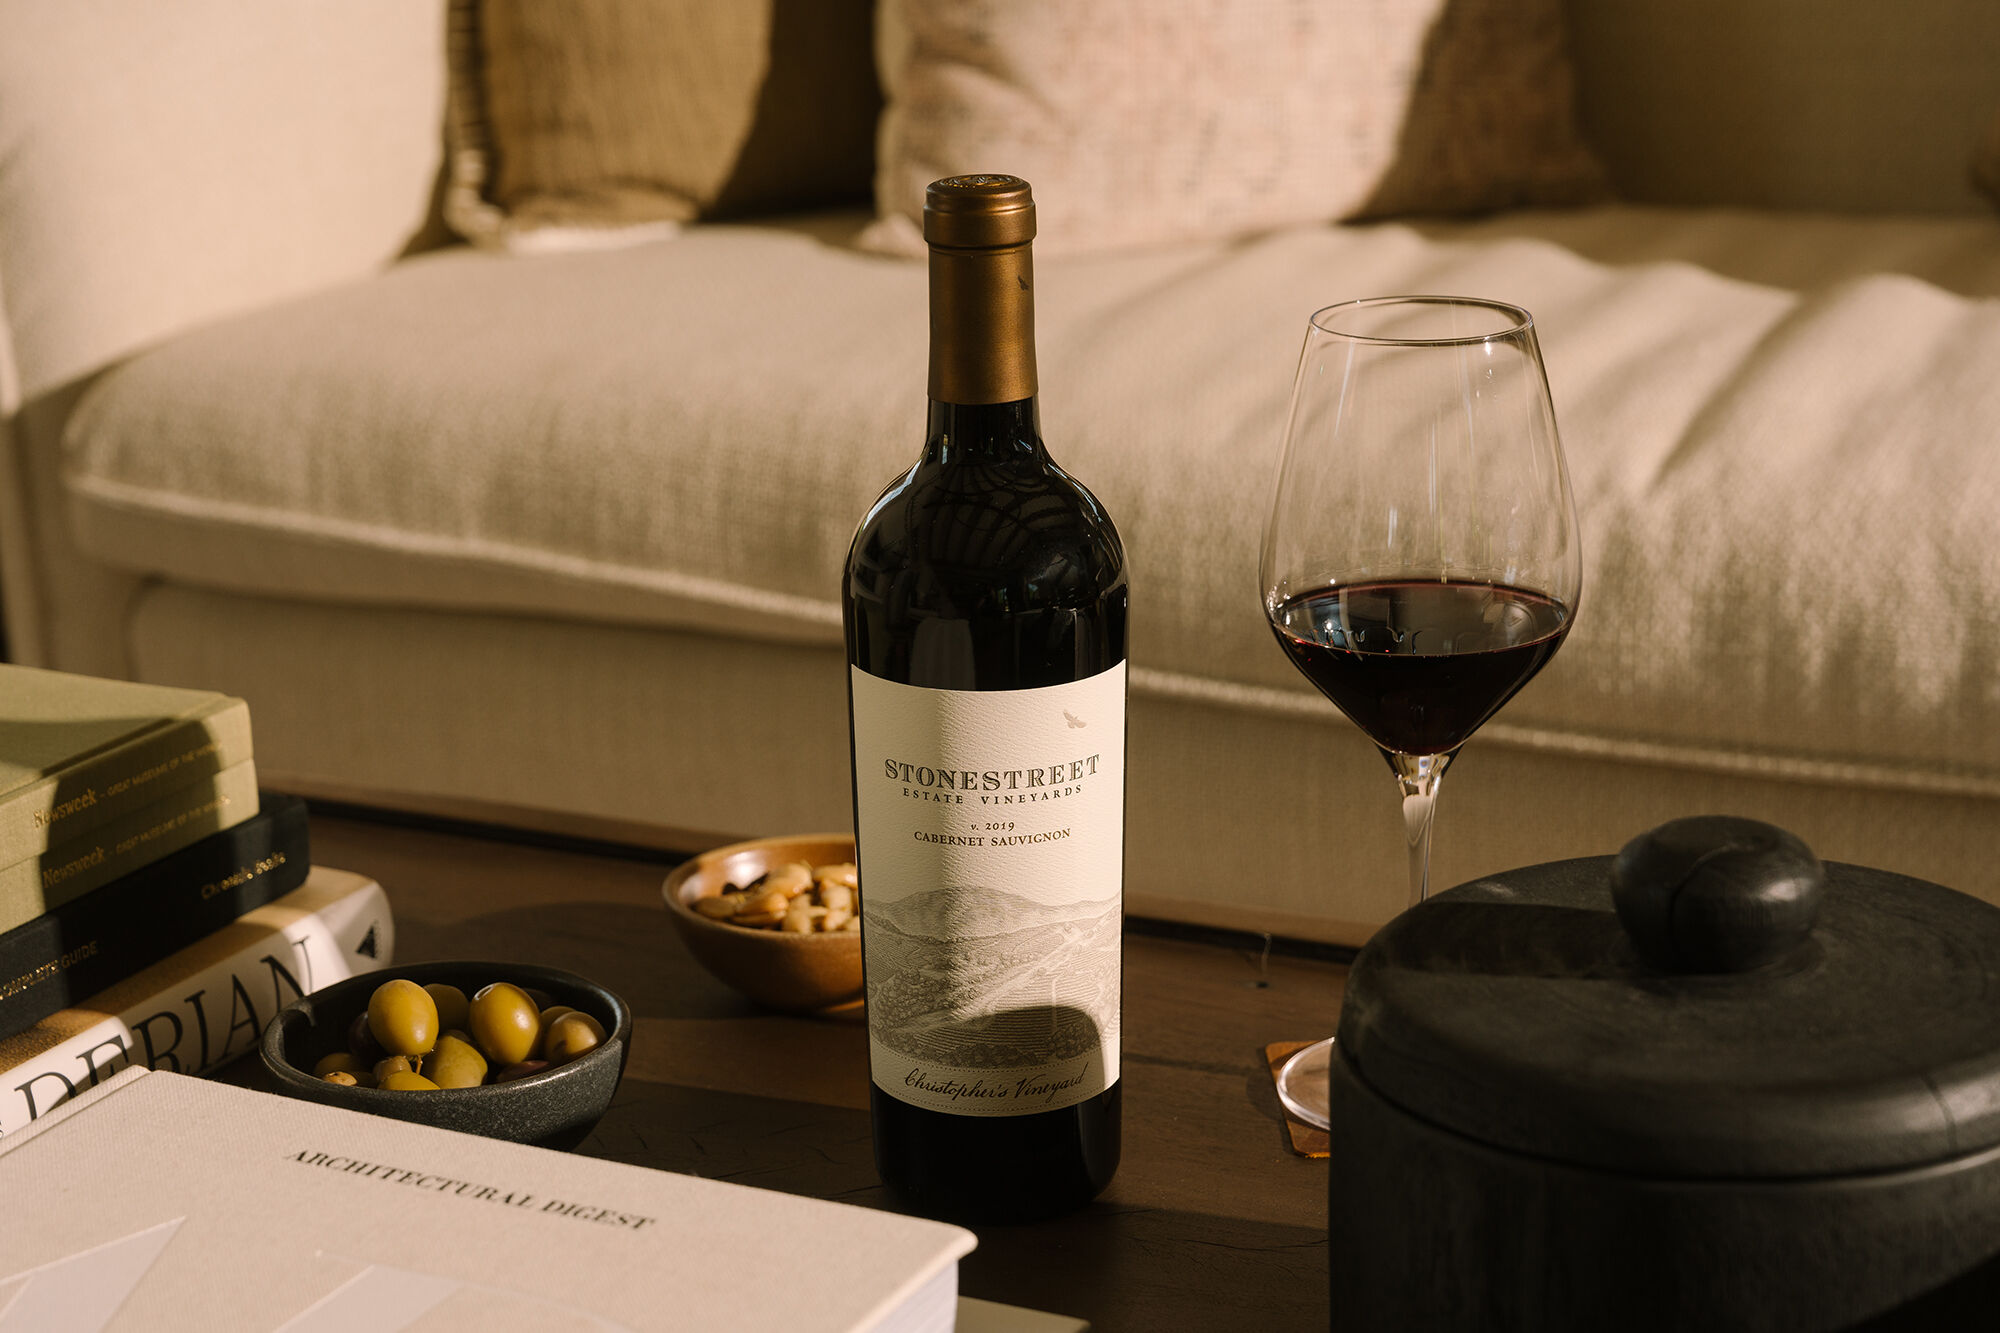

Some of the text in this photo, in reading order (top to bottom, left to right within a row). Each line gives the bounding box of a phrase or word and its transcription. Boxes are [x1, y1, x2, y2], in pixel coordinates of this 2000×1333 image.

[884, 753, 1100, 791] STONESTREET
[33, 787, 98, 829] Newsweek
[903, 784, 1082, 805] ESTATE VINEYARDS
[914, 827, 1071, 847] CABERNET SAUVIGNON
[985, 821, 1015, 832] 2019
[43, 846, 105, 888] Newsweek
[0, 940, 97, 1000] OMPLETE GUIDE
[904, 1061, 1089, 1104] Christopher's Vineyard
[286, 1150, 656, 1230] ARCHITECTURAL DIGEST
